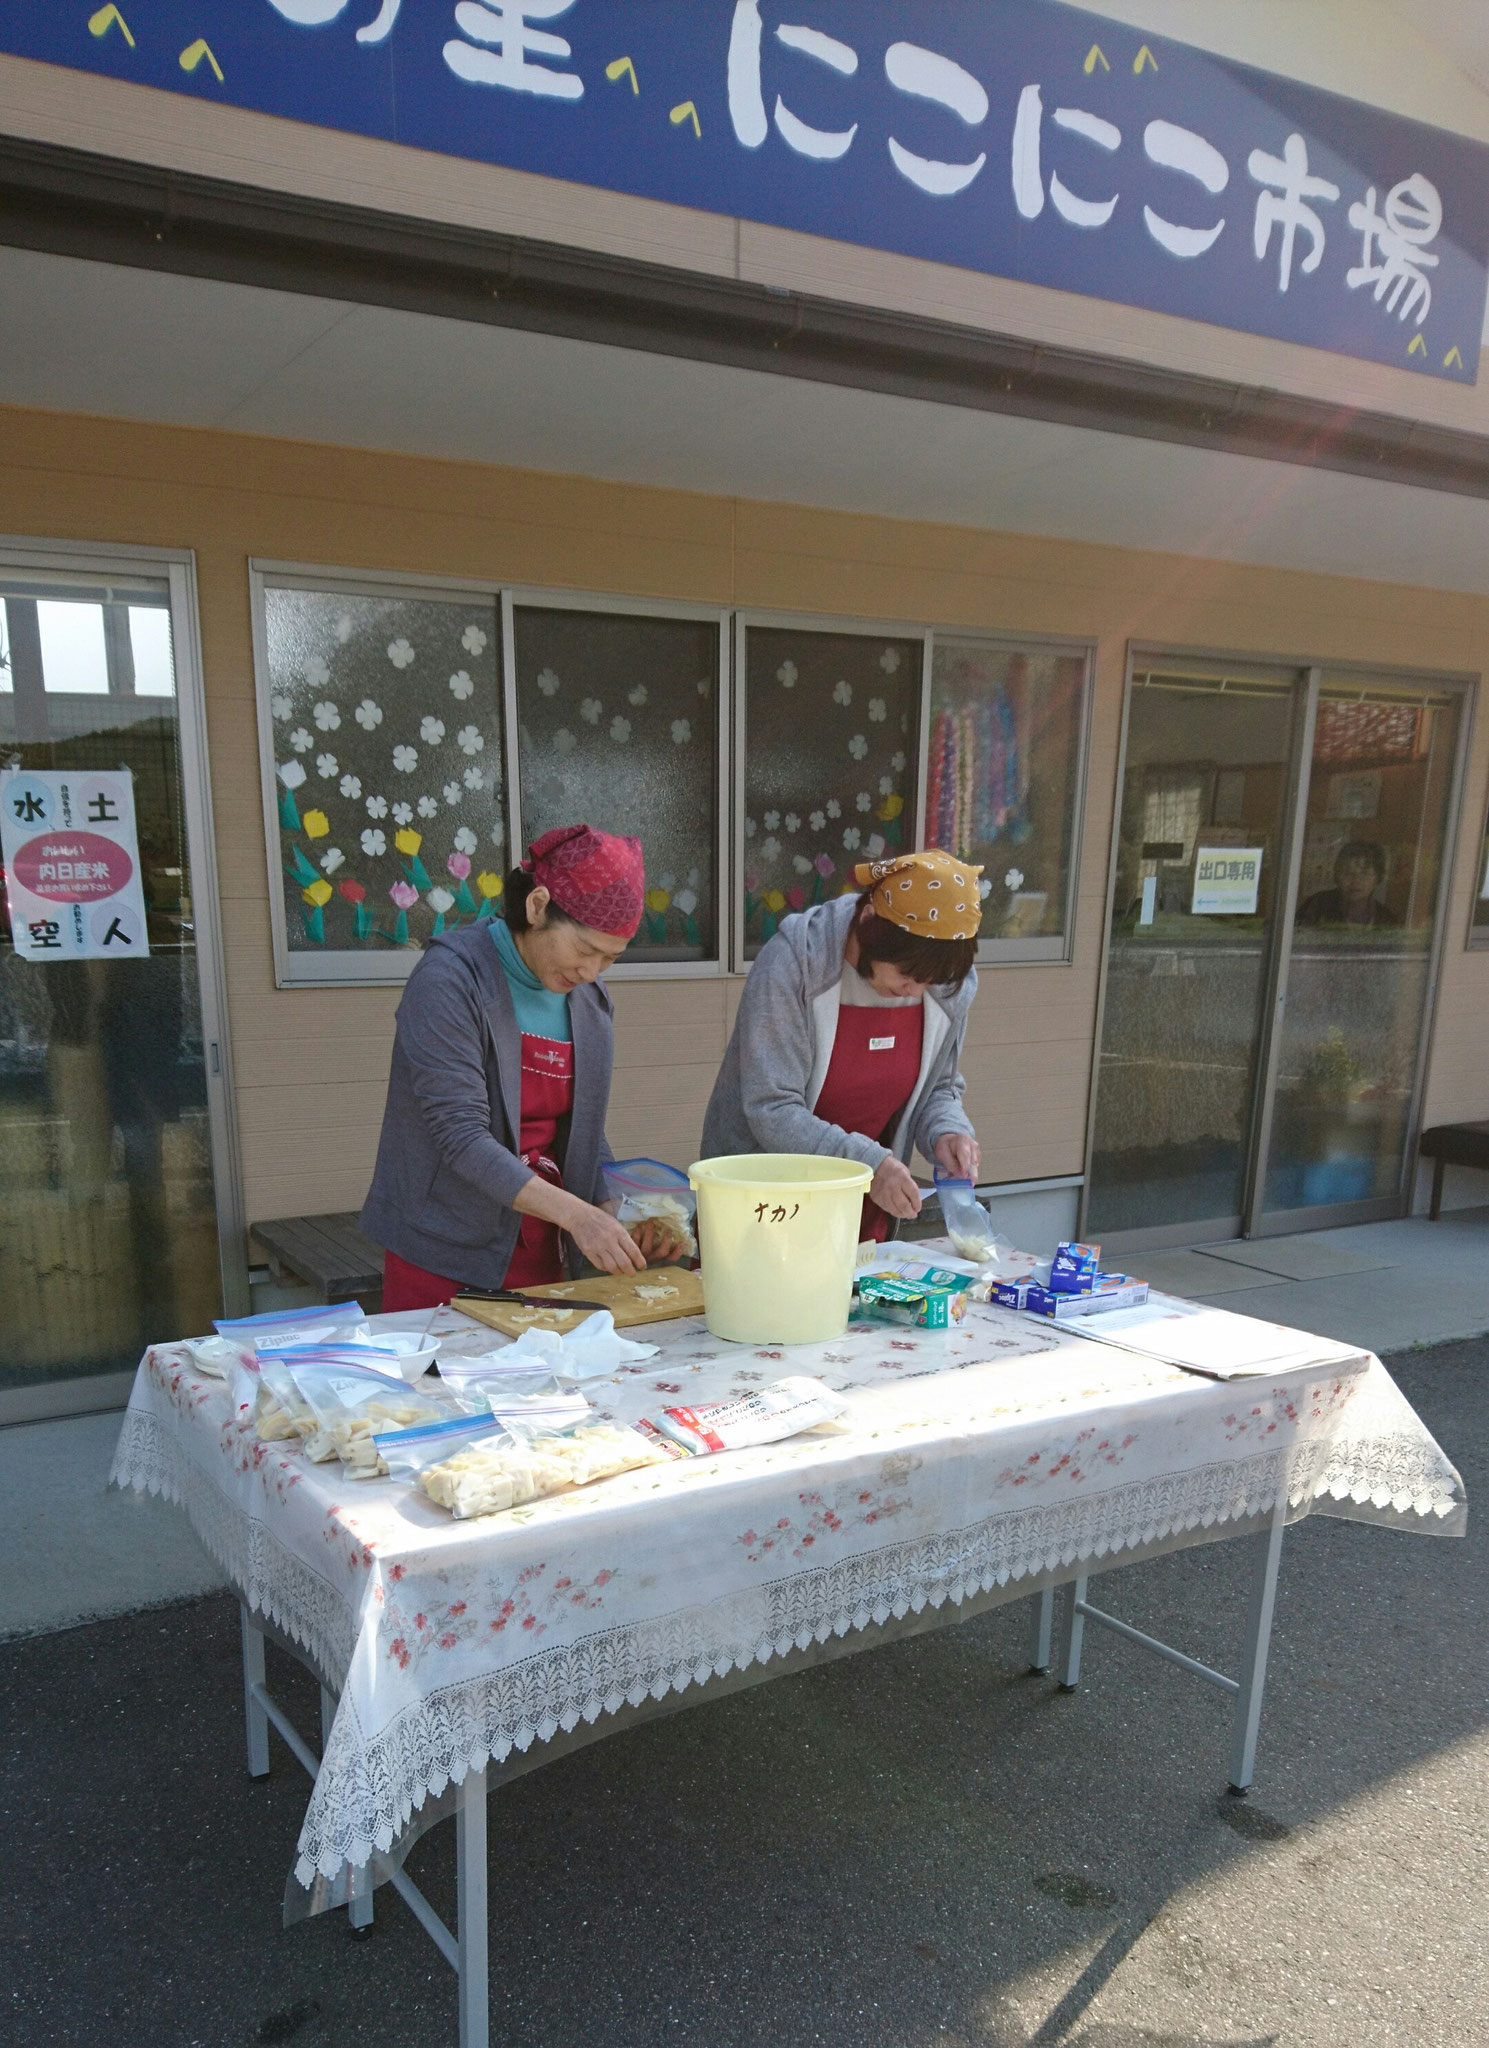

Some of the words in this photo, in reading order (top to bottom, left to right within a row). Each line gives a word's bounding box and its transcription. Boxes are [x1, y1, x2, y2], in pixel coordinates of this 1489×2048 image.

[728, 0, 1443, 325] にこにこ市場
[14, 791, 47, 822] 水
[88, 792, 119, 822] 土
[38, 861, 110, 880] 内日産米
[1199, 860, 1256, 880] 出口専用
[29, 919, 62, 948] 空
[102, 917, 132, 945] 人
[754, 1202, 799, 1223] ナカノ
[257, 1333, 301, 1348] Ziploc
